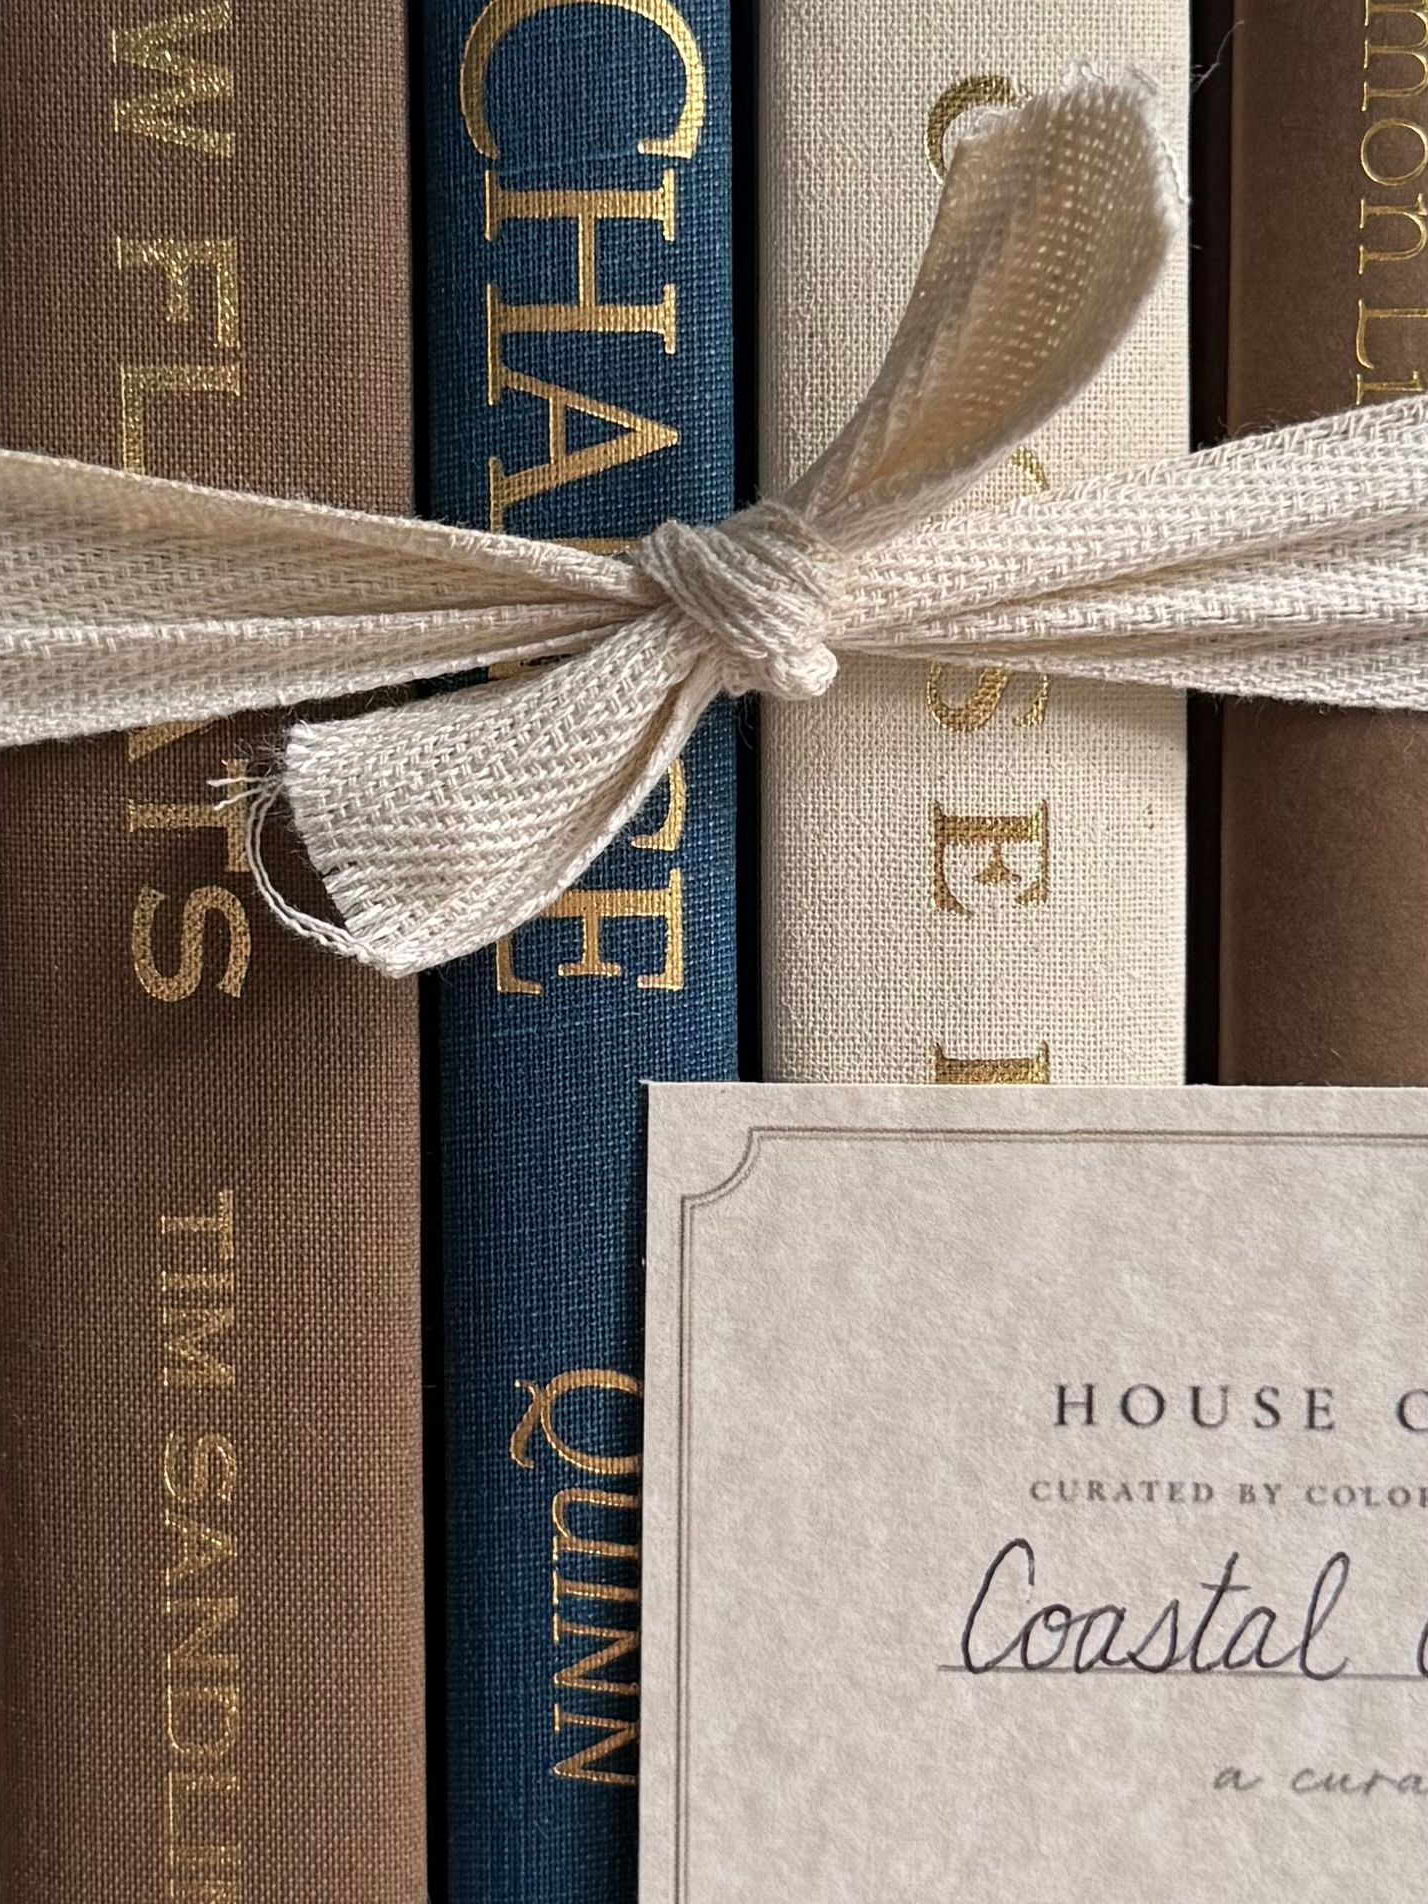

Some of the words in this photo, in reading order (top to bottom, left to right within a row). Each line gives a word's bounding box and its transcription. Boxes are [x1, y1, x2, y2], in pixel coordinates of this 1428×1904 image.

[117, 235, 252, 1003] FLTS
[161, 1189, 237, 1389] TIM
[1052, 1381, 1337, 1434] HOUSE
[1028, 1478, 1215, 1505] CURATED
[1237, 1482, 1283, 1507] BY
[959, 1537, 1351, 1680] Coastal
[1212, 1765, 1263, 1794] a
